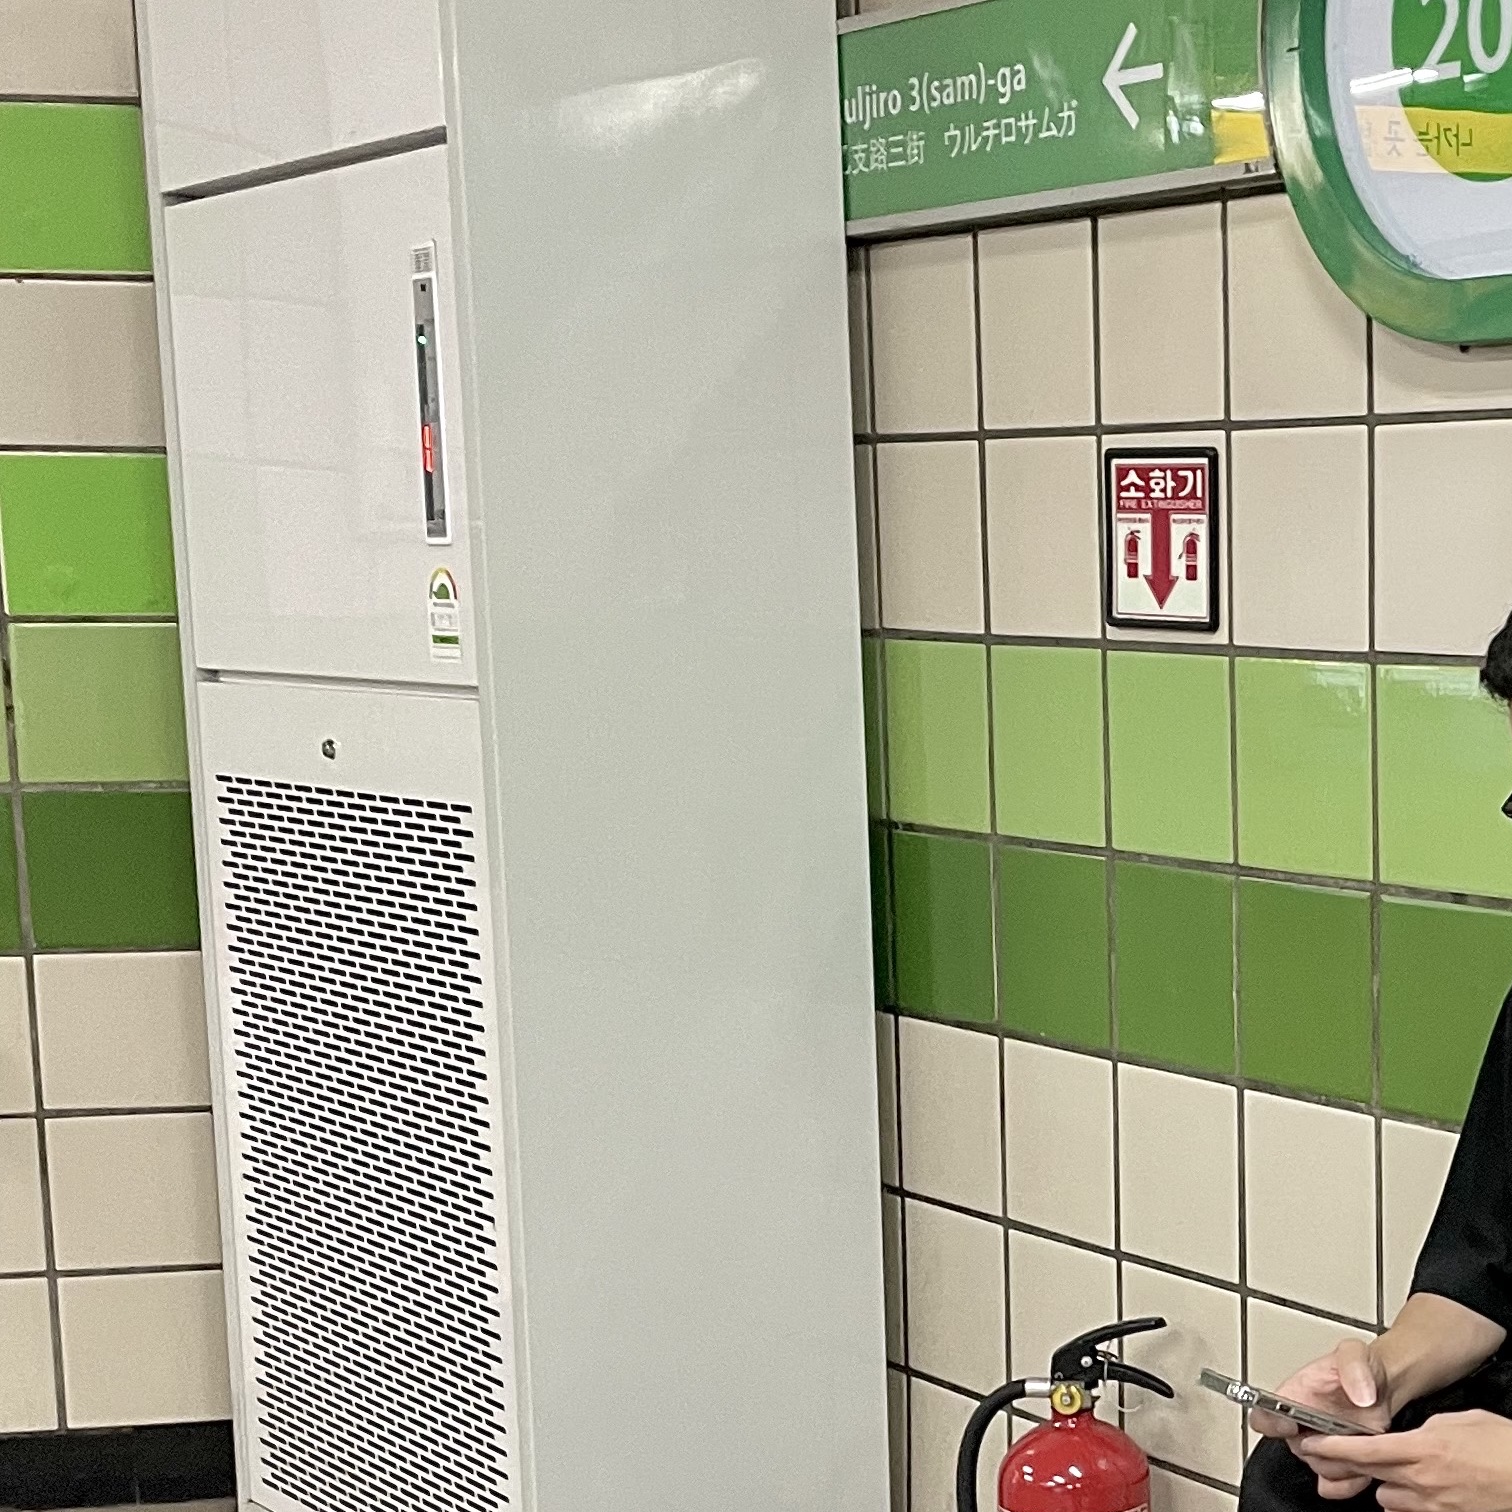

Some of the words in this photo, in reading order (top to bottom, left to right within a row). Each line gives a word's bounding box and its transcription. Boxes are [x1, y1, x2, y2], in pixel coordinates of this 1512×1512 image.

[907, 62, 1026, 114] 3(sam)-ga
[944, 99, 1079, 157] ウルチロサムガ
[1119, 468, 1203, 499] 소화기
